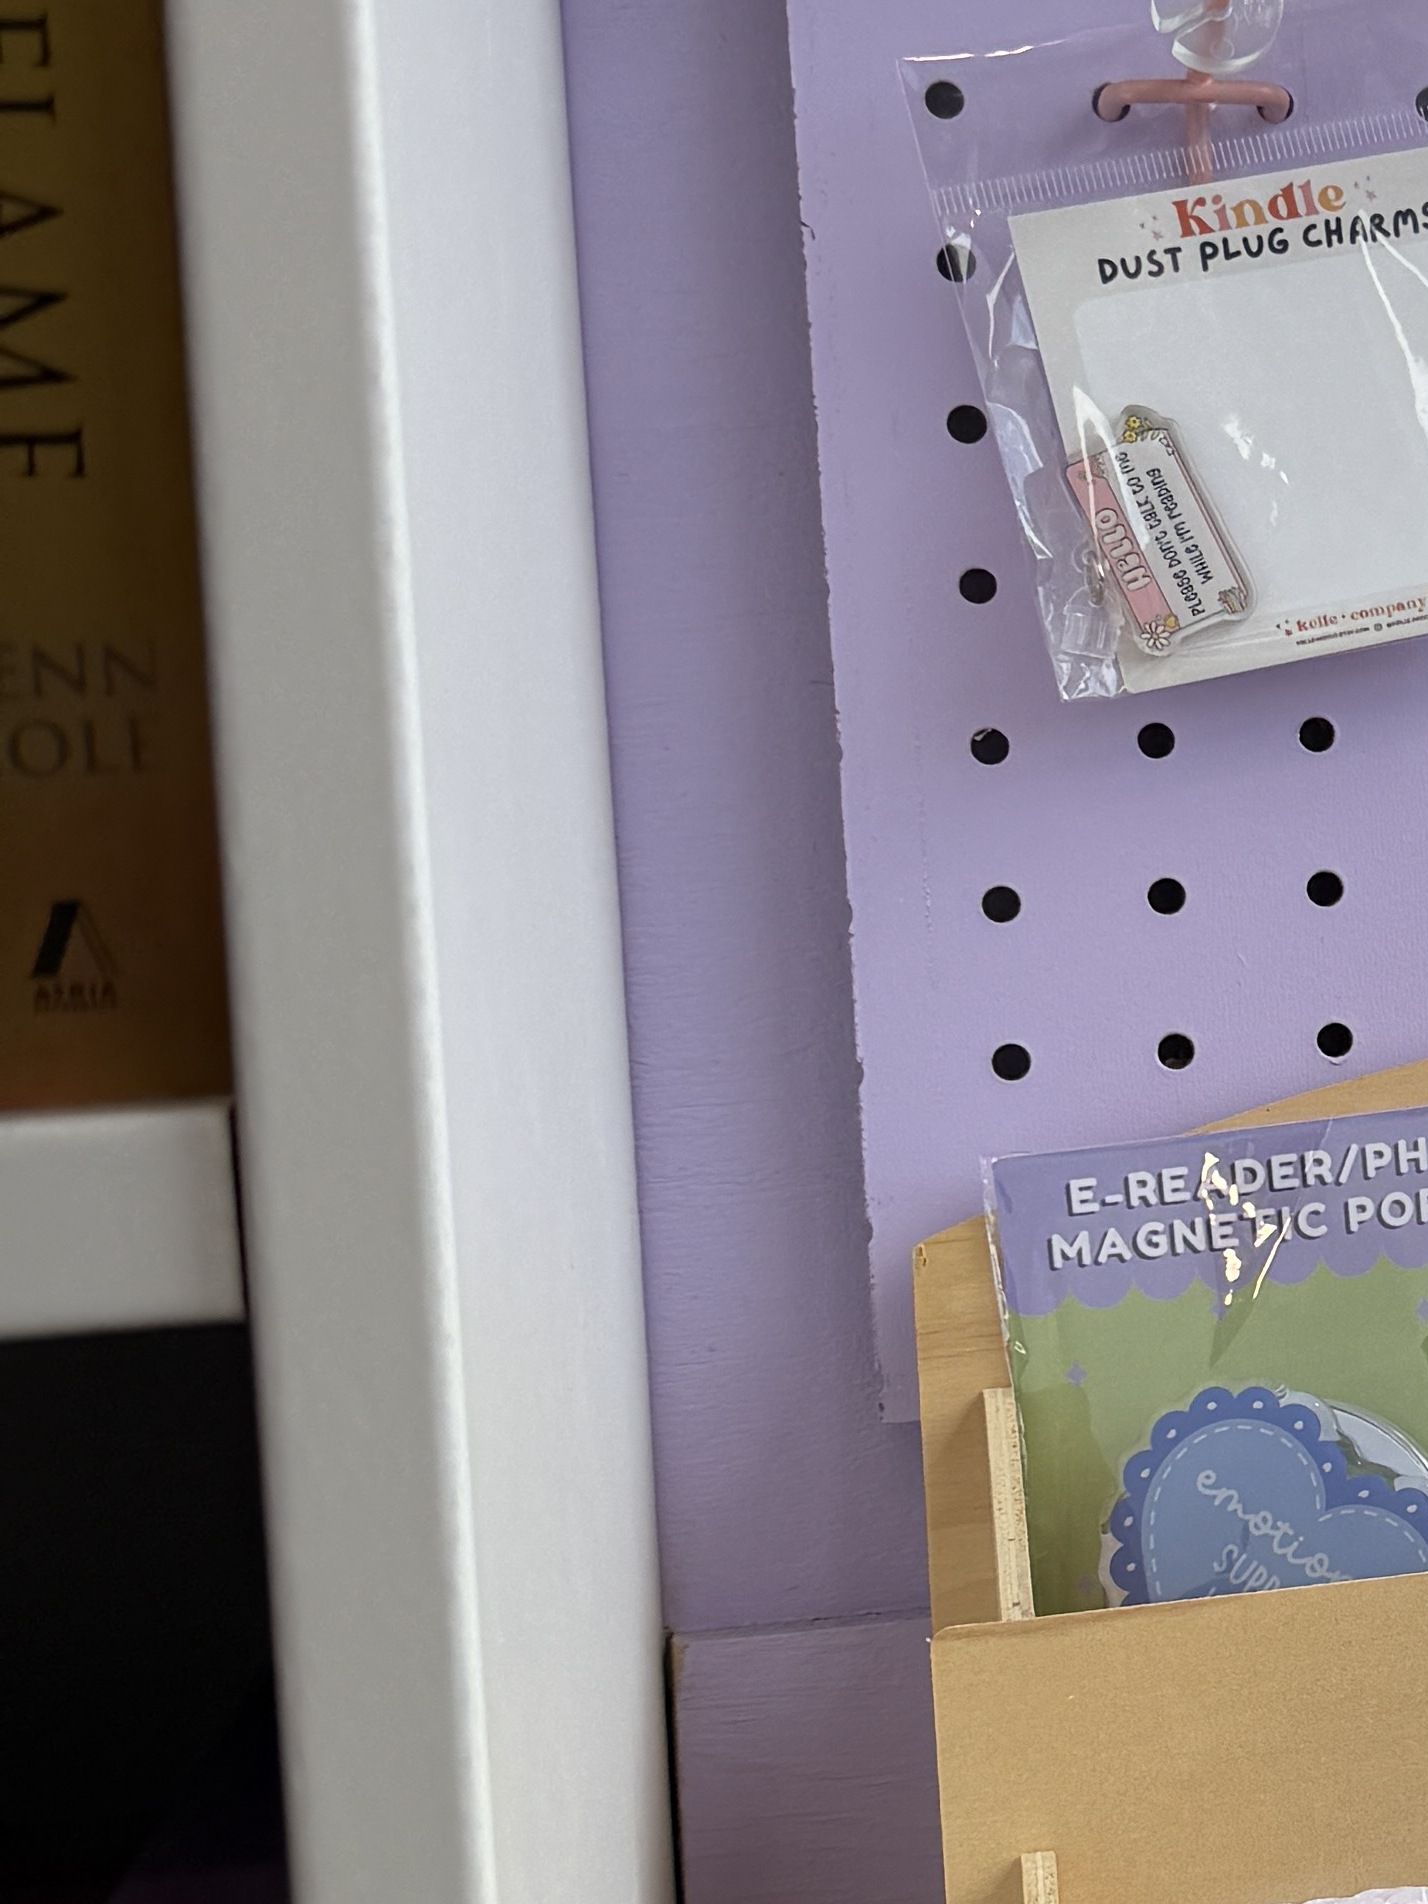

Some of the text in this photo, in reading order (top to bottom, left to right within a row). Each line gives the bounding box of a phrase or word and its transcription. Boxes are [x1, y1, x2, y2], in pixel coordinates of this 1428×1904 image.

[1171, 180, 1346, 241] Kindle
[1099, 247, 1184, 284] DUST
[1200, 227, 1289, 273] PLUG
[1048, 1203, 1328, 1271] MAGNETIC
